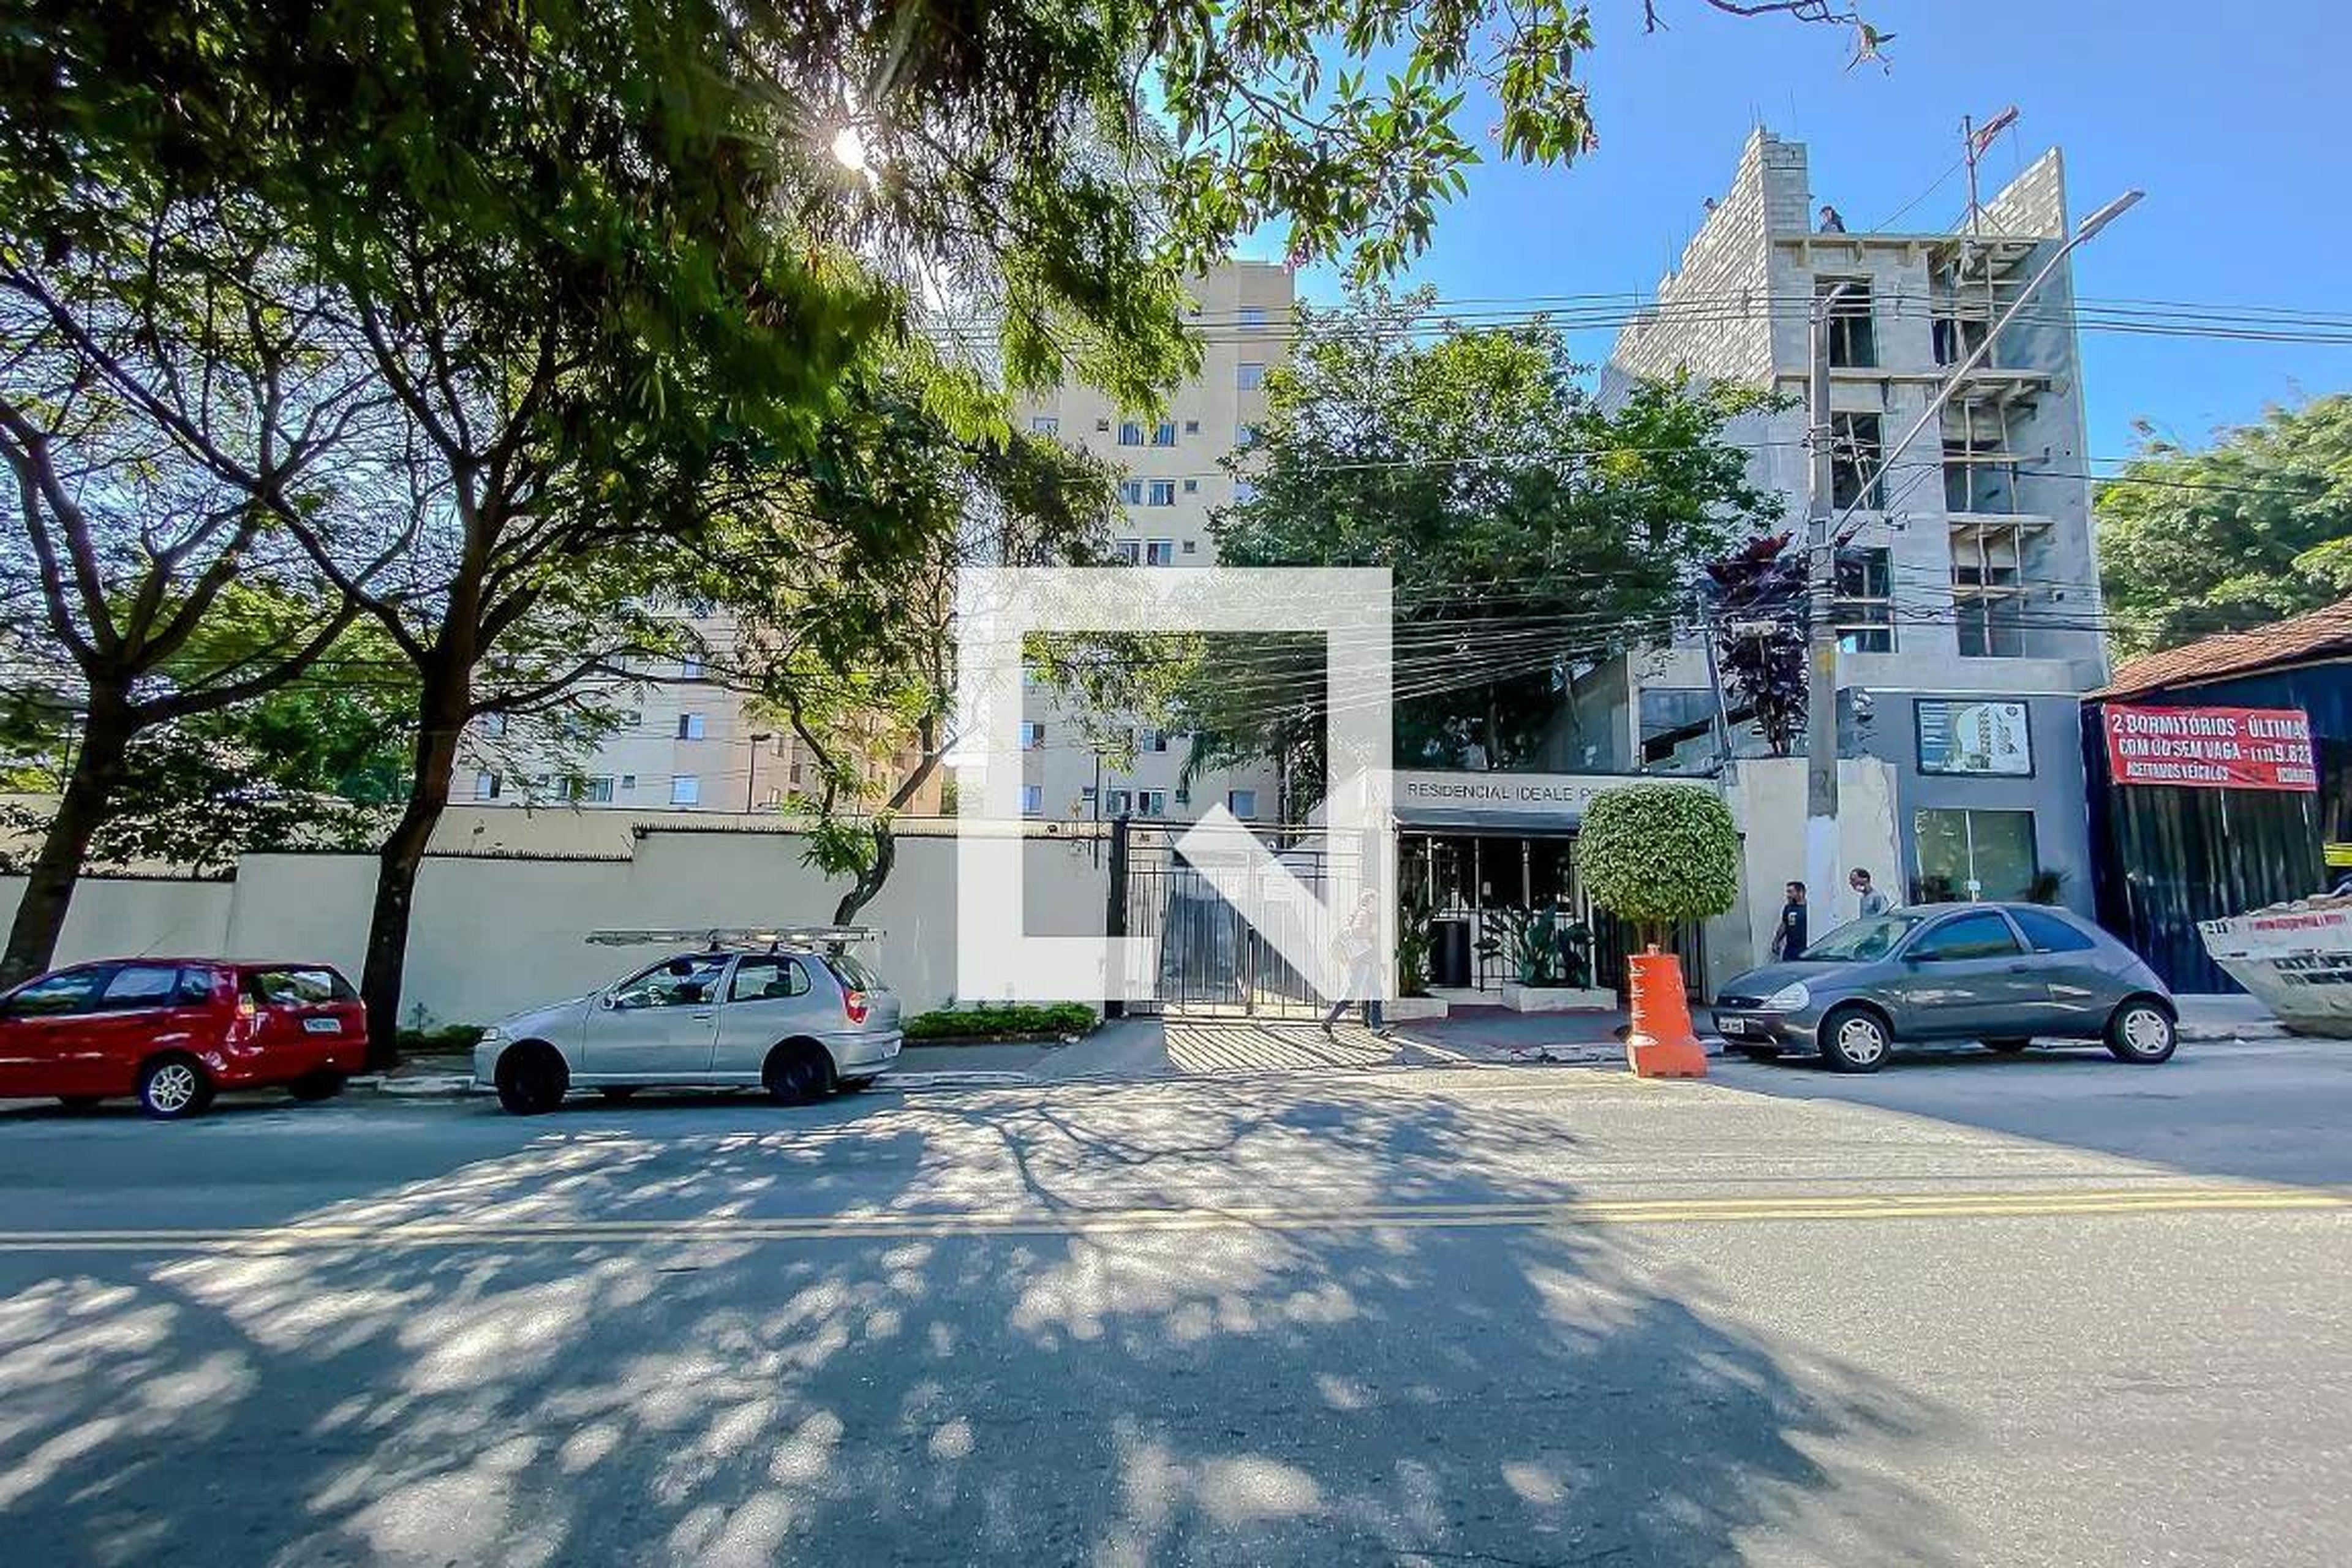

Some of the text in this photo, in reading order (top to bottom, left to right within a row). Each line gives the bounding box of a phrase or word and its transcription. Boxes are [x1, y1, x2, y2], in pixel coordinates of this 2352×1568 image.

[2113, 714, 2123, 733] 2
[2126, 712, 2236, 736] DORMITÓRIOS
[2119, 738, 2149, 756] COM
[2152, 739, 2171, 756] OU
[2173, 741, 2201, 758] SEM
[2204, 741, 2241, 760] VAGA
[1408, 783, 1510, 799] RESIDENCIAL
[1517, 786, 1573, 801] IDEALE
